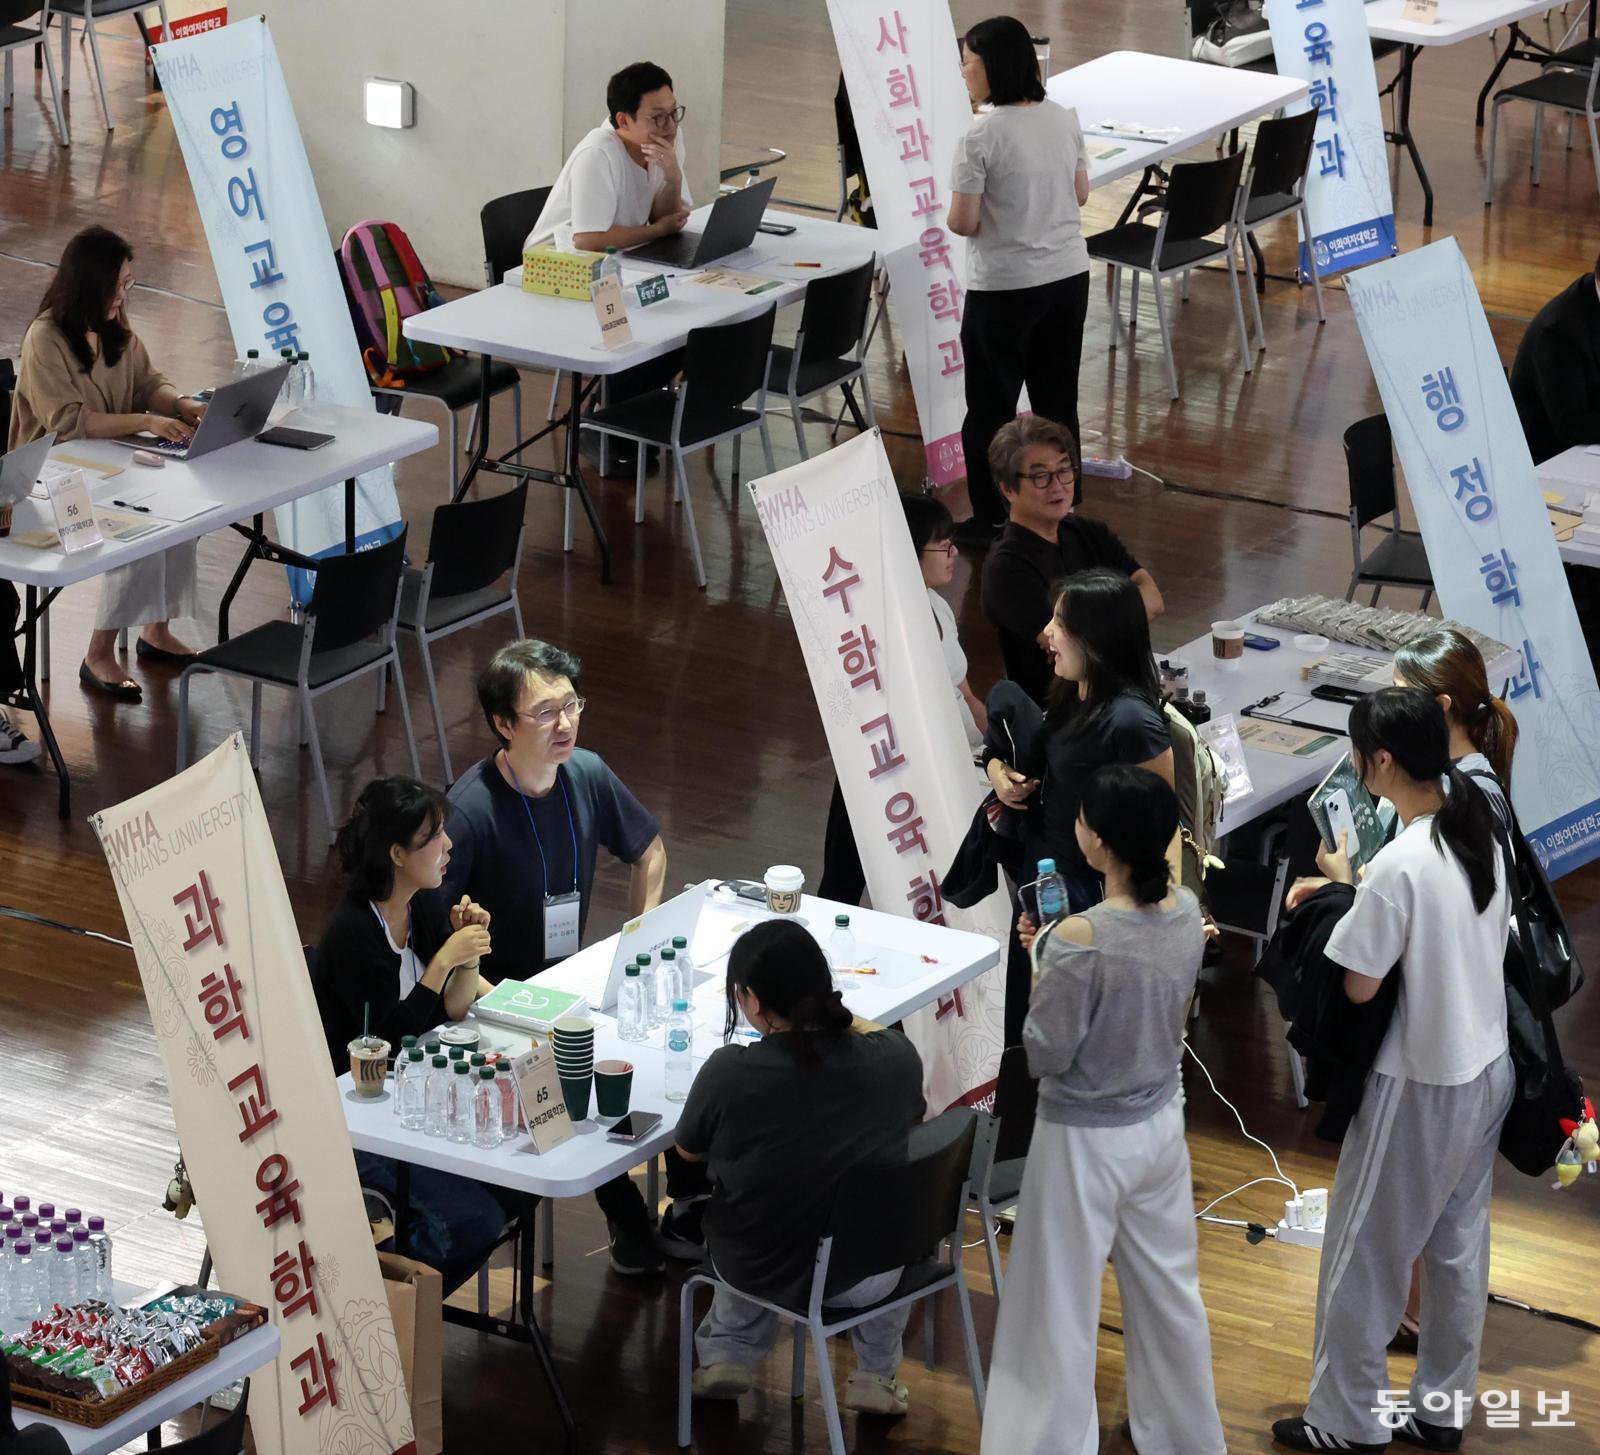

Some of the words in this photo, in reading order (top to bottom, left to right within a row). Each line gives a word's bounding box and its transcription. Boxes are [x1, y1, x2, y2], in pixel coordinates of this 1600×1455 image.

[175, 17, 221, 37] 이화여자대학교
[1296, 0, 1344, 178] 육학과
[1329, 227, 1378, 252] 이화여자대학교
[606, 303, 615, 315] 57
[67, 503, 79, 516] 56
[768, 512, 816, 548] OMANS
[815, 476, 889, 527] UNIVERSITY
[1422, 366, 1542, 699] 행정학과
[114, 837, 170, 888] OMANS
[167, 787, 254, 856] UNIVERSITY
[536, 1086, 549, 1104] 65
[528, 1102, 566, 1130] 수학교육학과
[173, 869, 338, 1416] 과학교육학과
